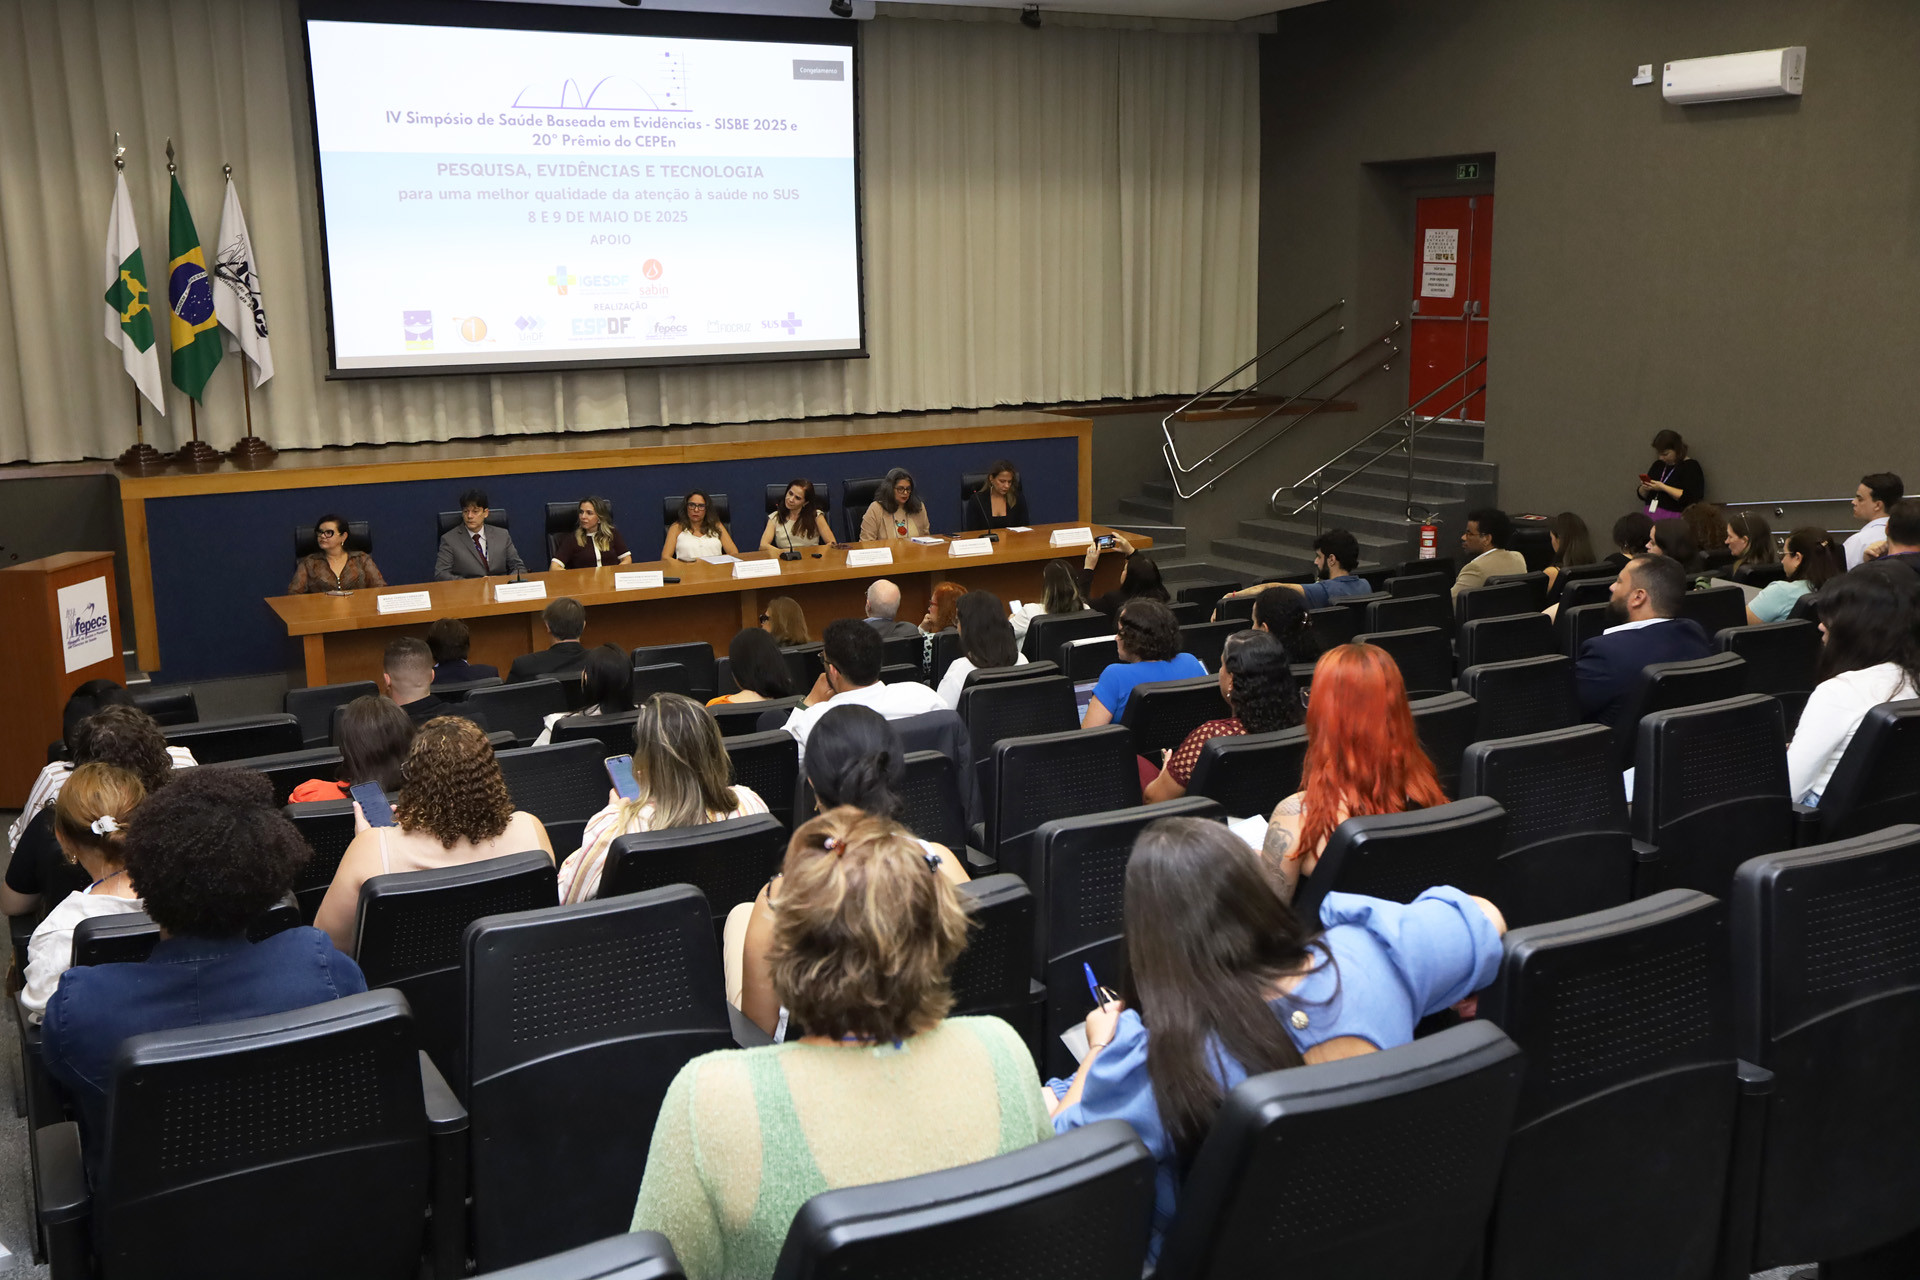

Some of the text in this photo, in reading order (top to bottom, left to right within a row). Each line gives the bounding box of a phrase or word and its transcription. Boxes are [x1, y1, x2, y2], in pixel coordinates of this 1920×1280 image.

[386, 111, 401, 123] IV
[407, 111, 472, 127] Simpósio
[477, 113, 494, 125] de
[499, 114, 543, 126] Saúde
[547, 115, 605, 127] Baseada
[634, 117, 701, 129] Evidências
[715, 118, 749, 130] SISBE
[754, 119, 787, 130] 2025
[790, 123, 798, 132] e
[562, 134, 610, 146] Prêmio
[615, 135, 631, 147] do
[635, 136, 675, 147] CEPEn
[437, 161, 764, 180] PESQUISA, EVIDÊNCIAS E TECNOLOGIA
[399, 187, 799, 203] para uma melhor qualidade da atenção à saúde no SUS
[528, 210, 688, 224] 8 E 9 DE MAIO DE 2025
[590, 234, 632, 245] APOIO
[639, 284, 669, 296] sabin
[593, 301, 648, 312] REALIZAÇÃO
[571, 317, 631, 335] ESPDF
[654, 322, 688, 335] fepecs
[761, 320, 780, 329] SUS
[75, 615, 107, 636] fepecs
